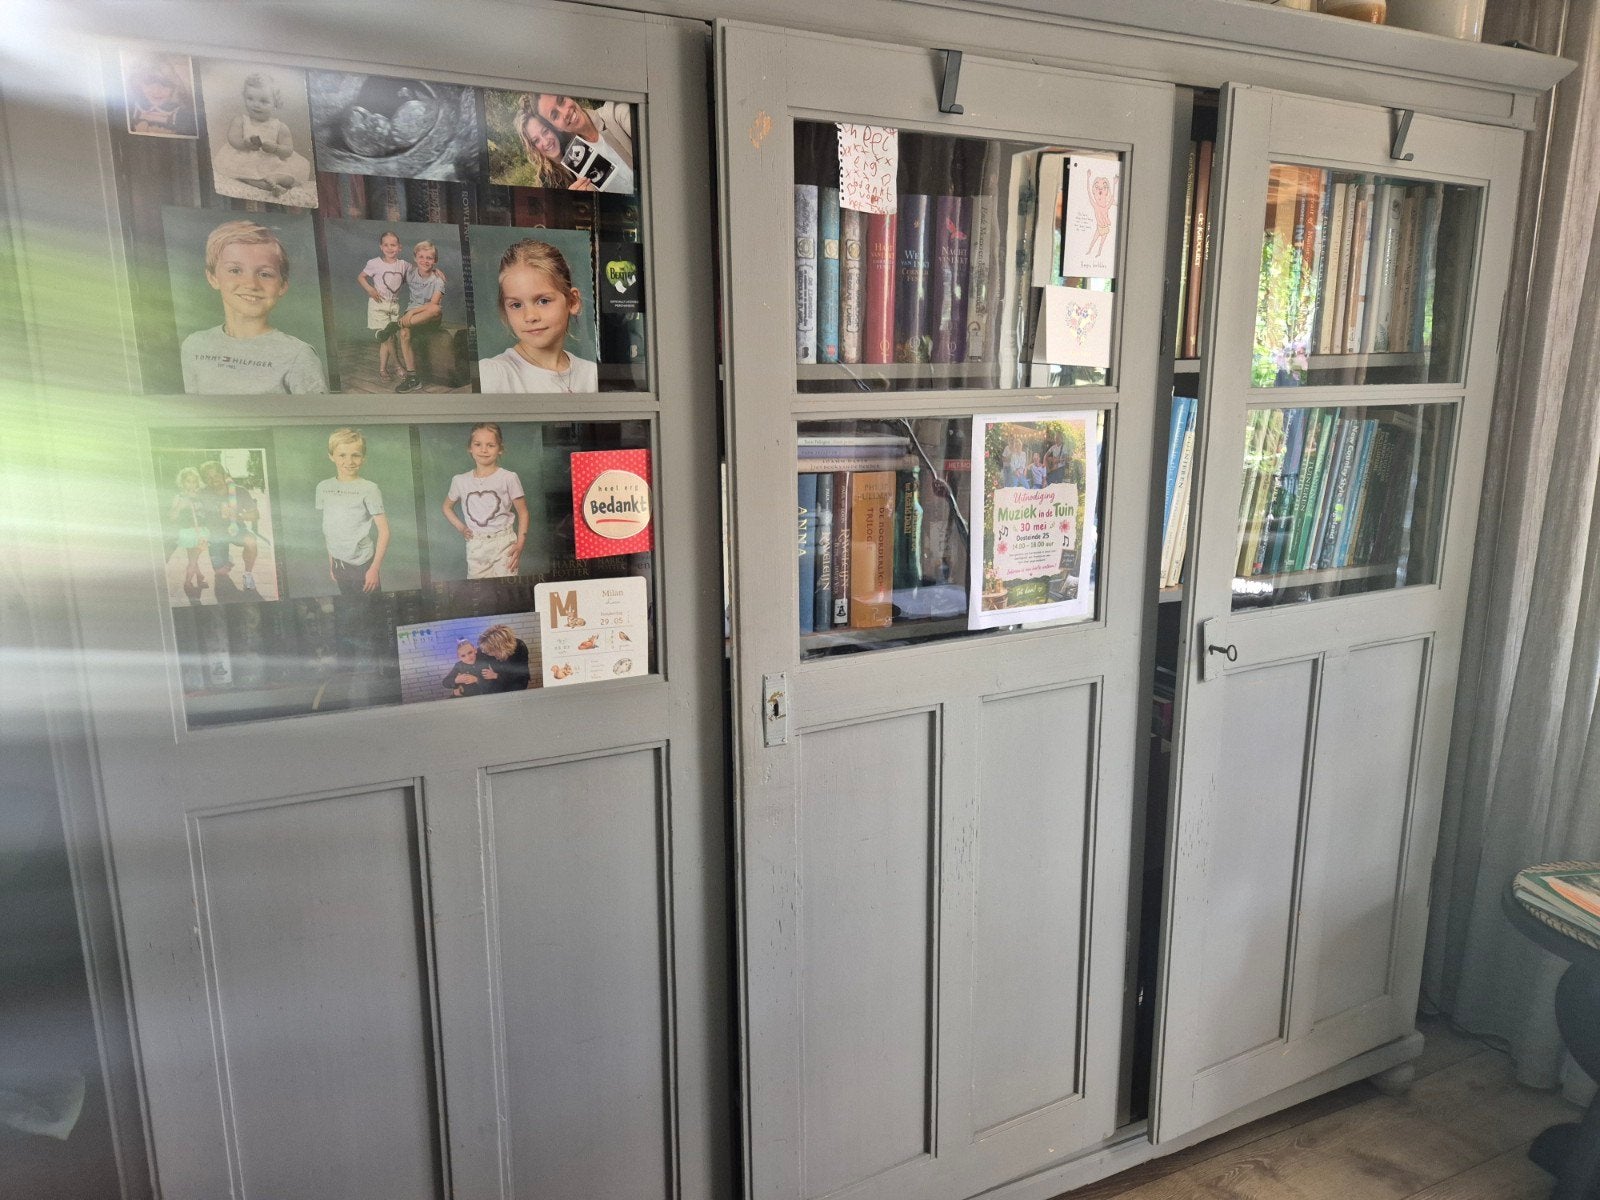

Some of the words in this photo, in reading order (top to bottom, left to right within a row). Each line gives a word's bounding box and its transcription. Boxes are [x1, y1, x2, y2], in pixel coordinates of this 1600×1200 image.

[460, 191, 470, 242] ROWLING
[233, 358, 272, 368] HILFIGER
[1341, 444, 1355, 476] Country
[1300, 461, 1313, 512] TUINIEREN
[1336, 477, 1347, 498] Style
[590, 494, 648, 514] Bedankt
[1014, 491, 1056, 505] Uitnodiging
[998, 504, 1037, 521] Muziek
[1046, 509, 1053, 517] de
[1053, 502, 1074, 517] Tuin
[798, 507, 808, 556] ANNA
[1020, 522, 1030, 532] 30
[1033, 521, 1047, 531] mei
[549, 590, 578, 629] M
